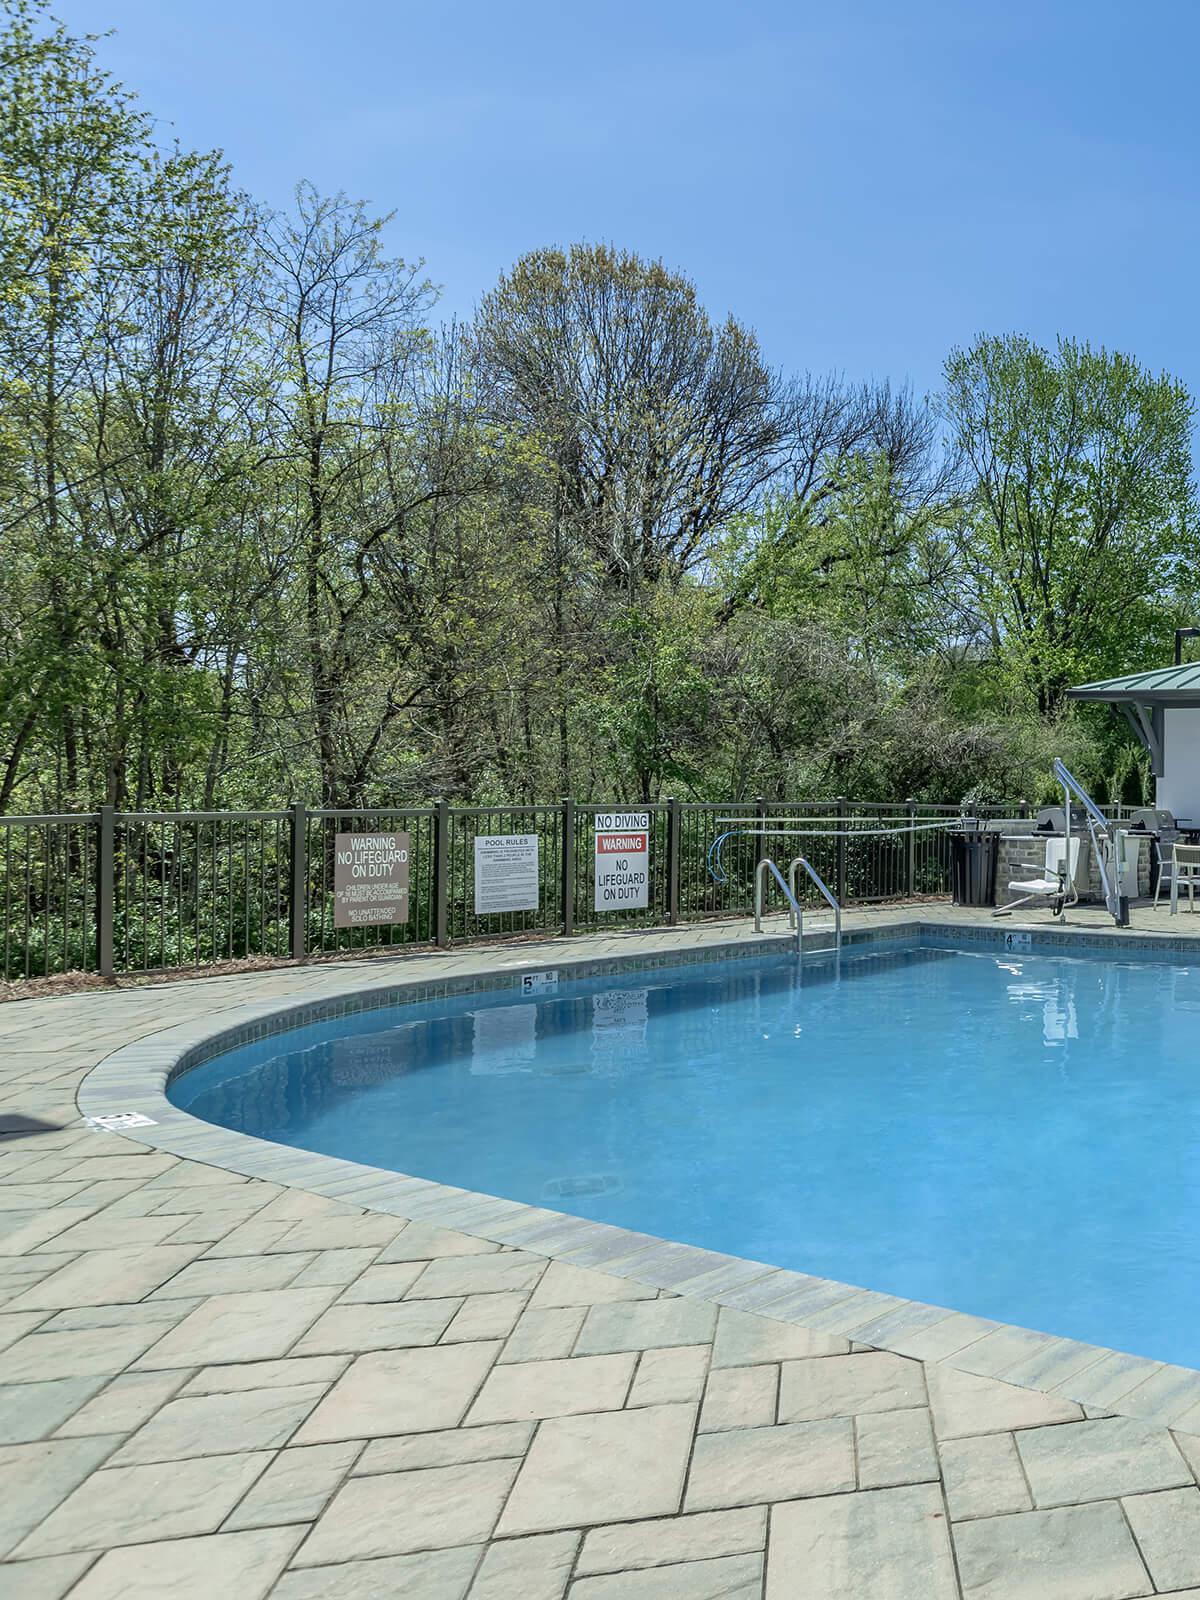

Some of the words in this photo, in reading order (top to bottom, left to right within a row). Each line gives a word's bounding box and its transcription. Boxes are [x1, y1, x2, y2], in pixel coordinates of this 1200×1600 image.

[597, 816, 612, 828] NO
[614, 816, 648, 828] DIVING
[350, 837, 396, 850] WARNING
[602, 838, 642, 850] WARNING
[337, 852, 352, 865] NO
[354, 850, 408, 864] LIFEGUARD
[352, 864, 366, 878] ON
[368, 864, 394, 876] DUTY
[616, 860, 628, 871] NO
[599, 873, 645, 886] LIFEGUARD
[604, 888, 616, 900] ON
[618, 887, 640, 899] DUTY
[524, 976, 532, 986] 5
